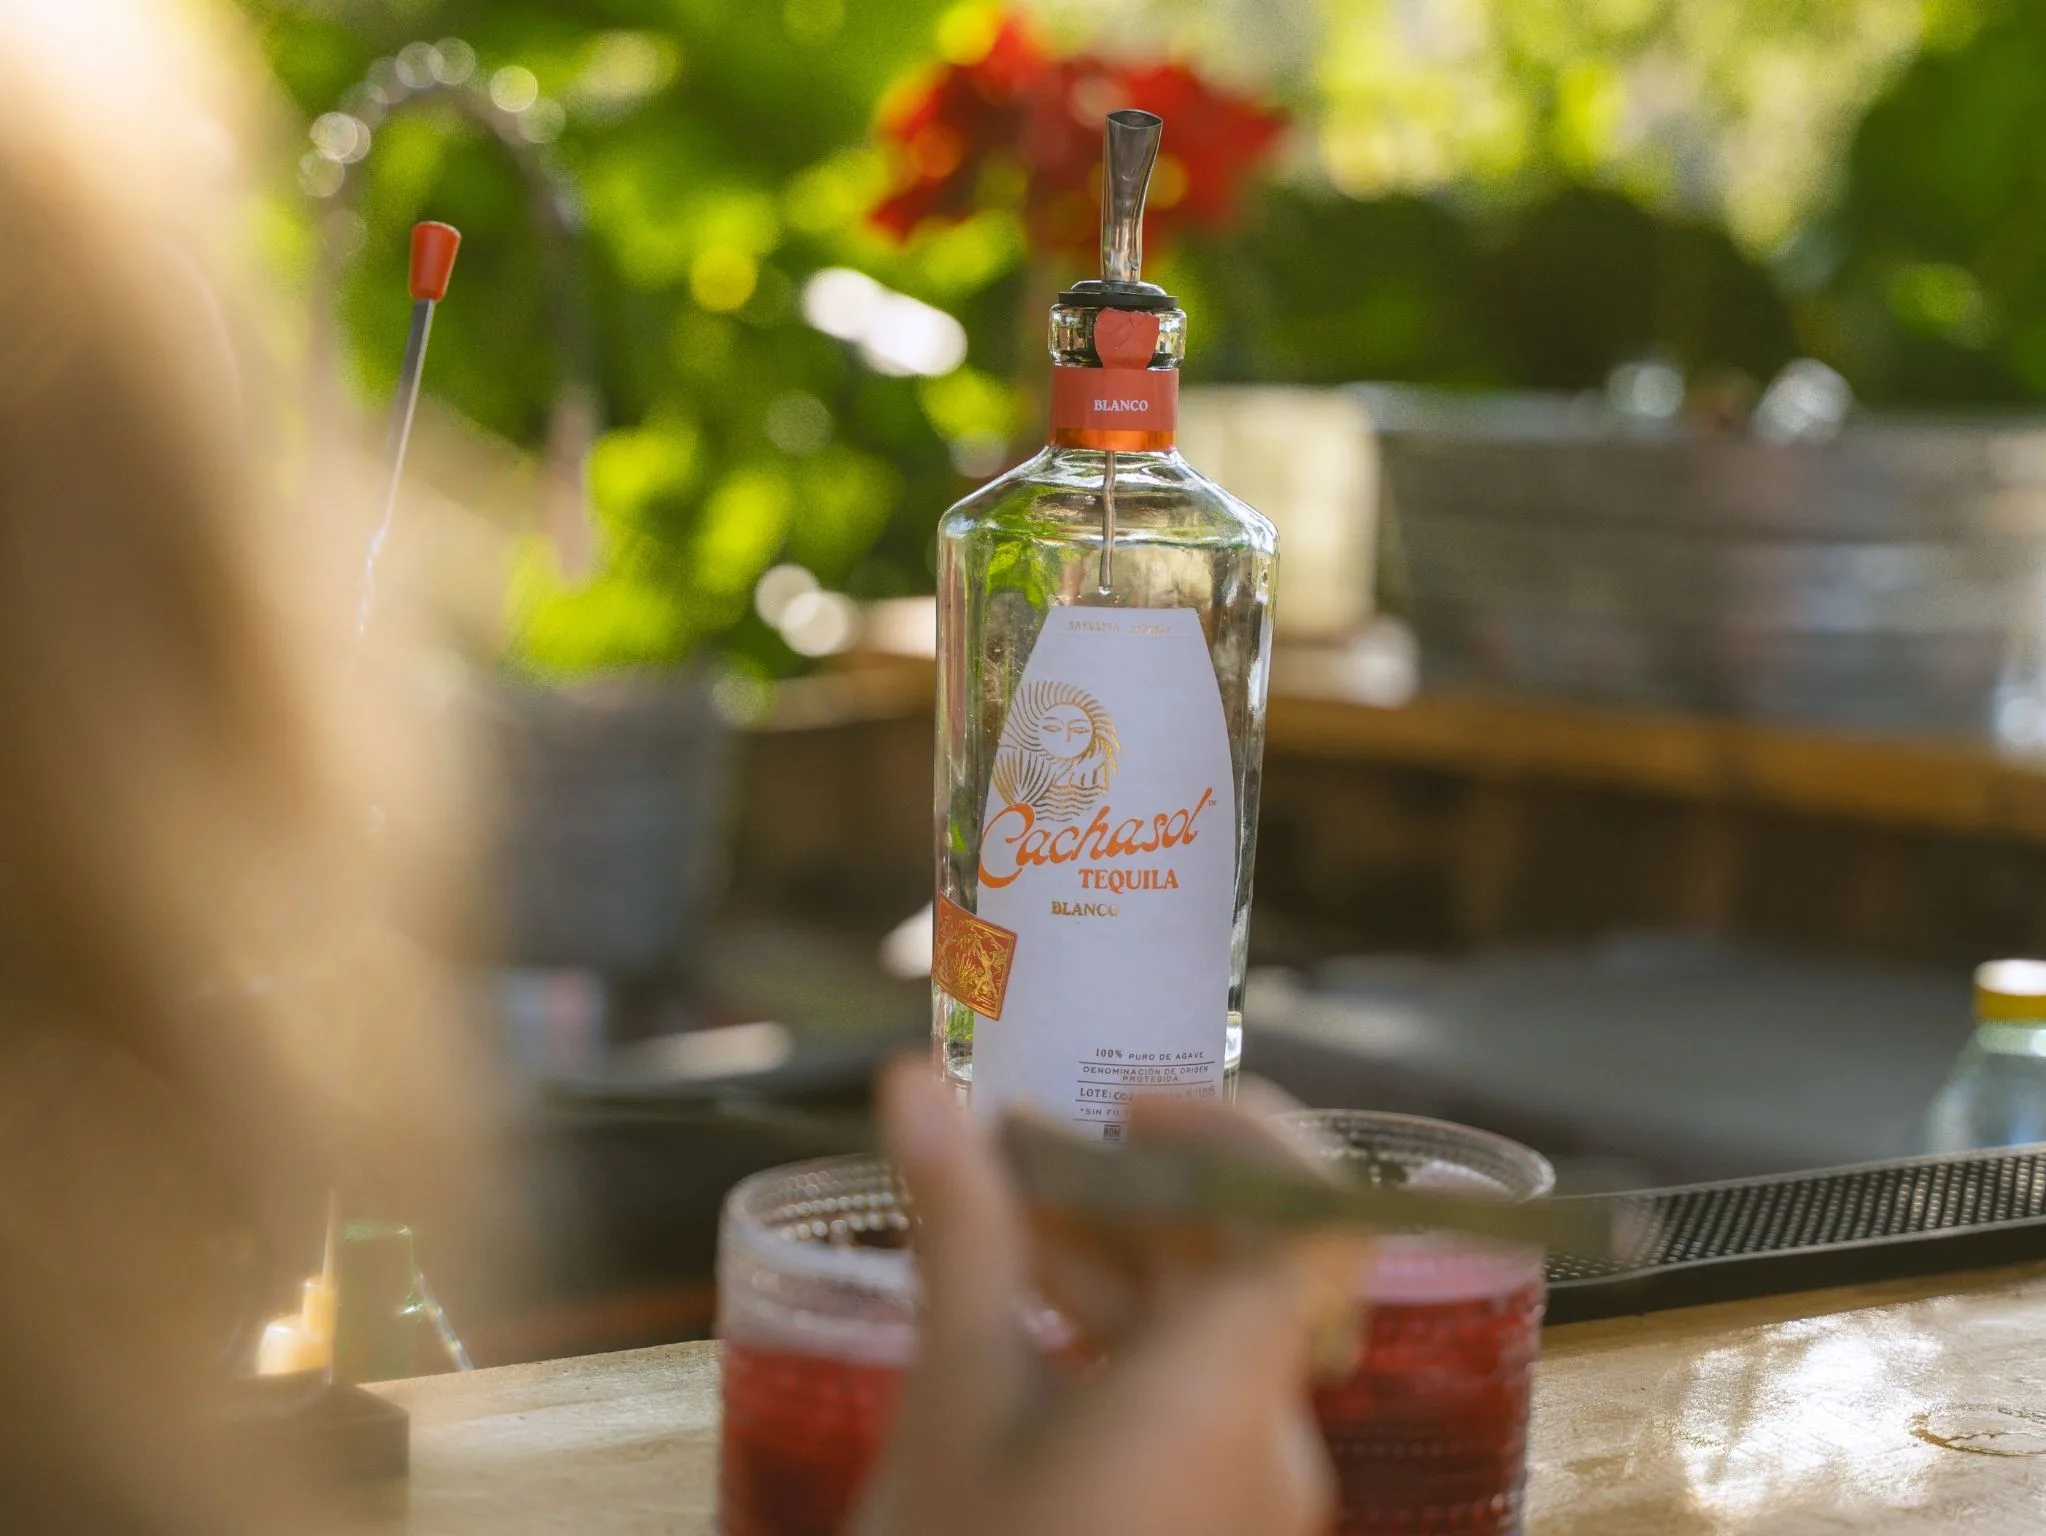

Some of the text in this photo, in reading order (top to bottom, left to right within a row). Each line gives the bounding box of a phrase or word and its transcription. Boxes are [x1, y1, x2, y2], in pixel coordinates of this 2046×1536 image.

[1094, 399, 1149, 412] BLANCO
[978, 787, 1212, 888] Cachasol
[1078, 869, 1179, 894] TEQUILA
[1051, 901, 1119, 917] BLANCO
[1096, 1048, 1123, 1059] 100%
[1128, 1053, 1155, 1061] PURO
[1175, 1051, 1204, 1060] AGAVE
[1164, 1067, 1176, 1075] DE
[1180, 1065, 1209, 1074] ORIGEN
[1121, 1074, 1179, 1082] PROTEGIDA
[1080, 1088, 1113, 1099] LOTE:
